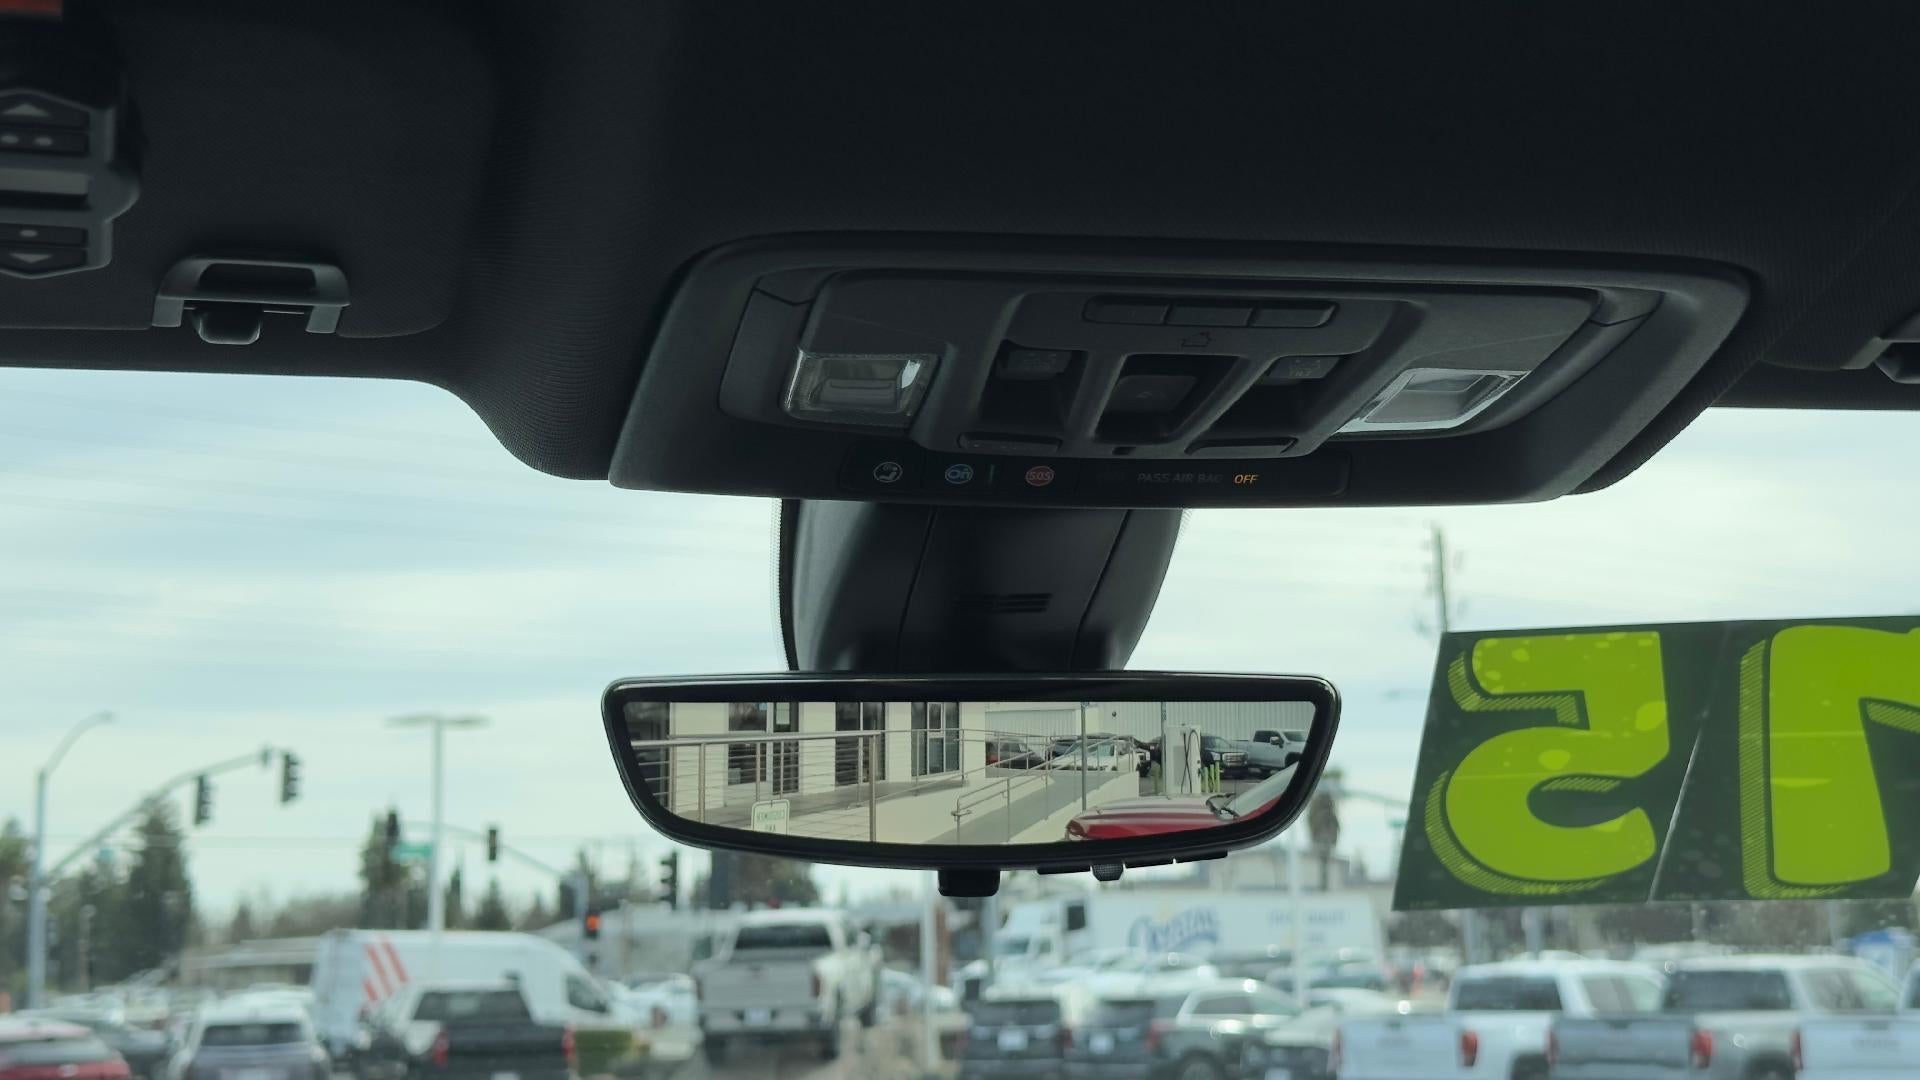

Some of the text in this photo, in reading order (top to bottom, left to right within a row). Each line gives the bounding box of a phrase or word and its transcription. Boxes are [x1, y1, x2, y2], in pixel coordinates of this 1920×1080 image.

[1028, 471, 1051, 481] SOS
[1137, 473, 1169, 484] PASS
[1172, 473, 1193, 484] AIR
[1197, 473, 1224, 484] BAG
[1234, 474, 1259, 484] OFF
